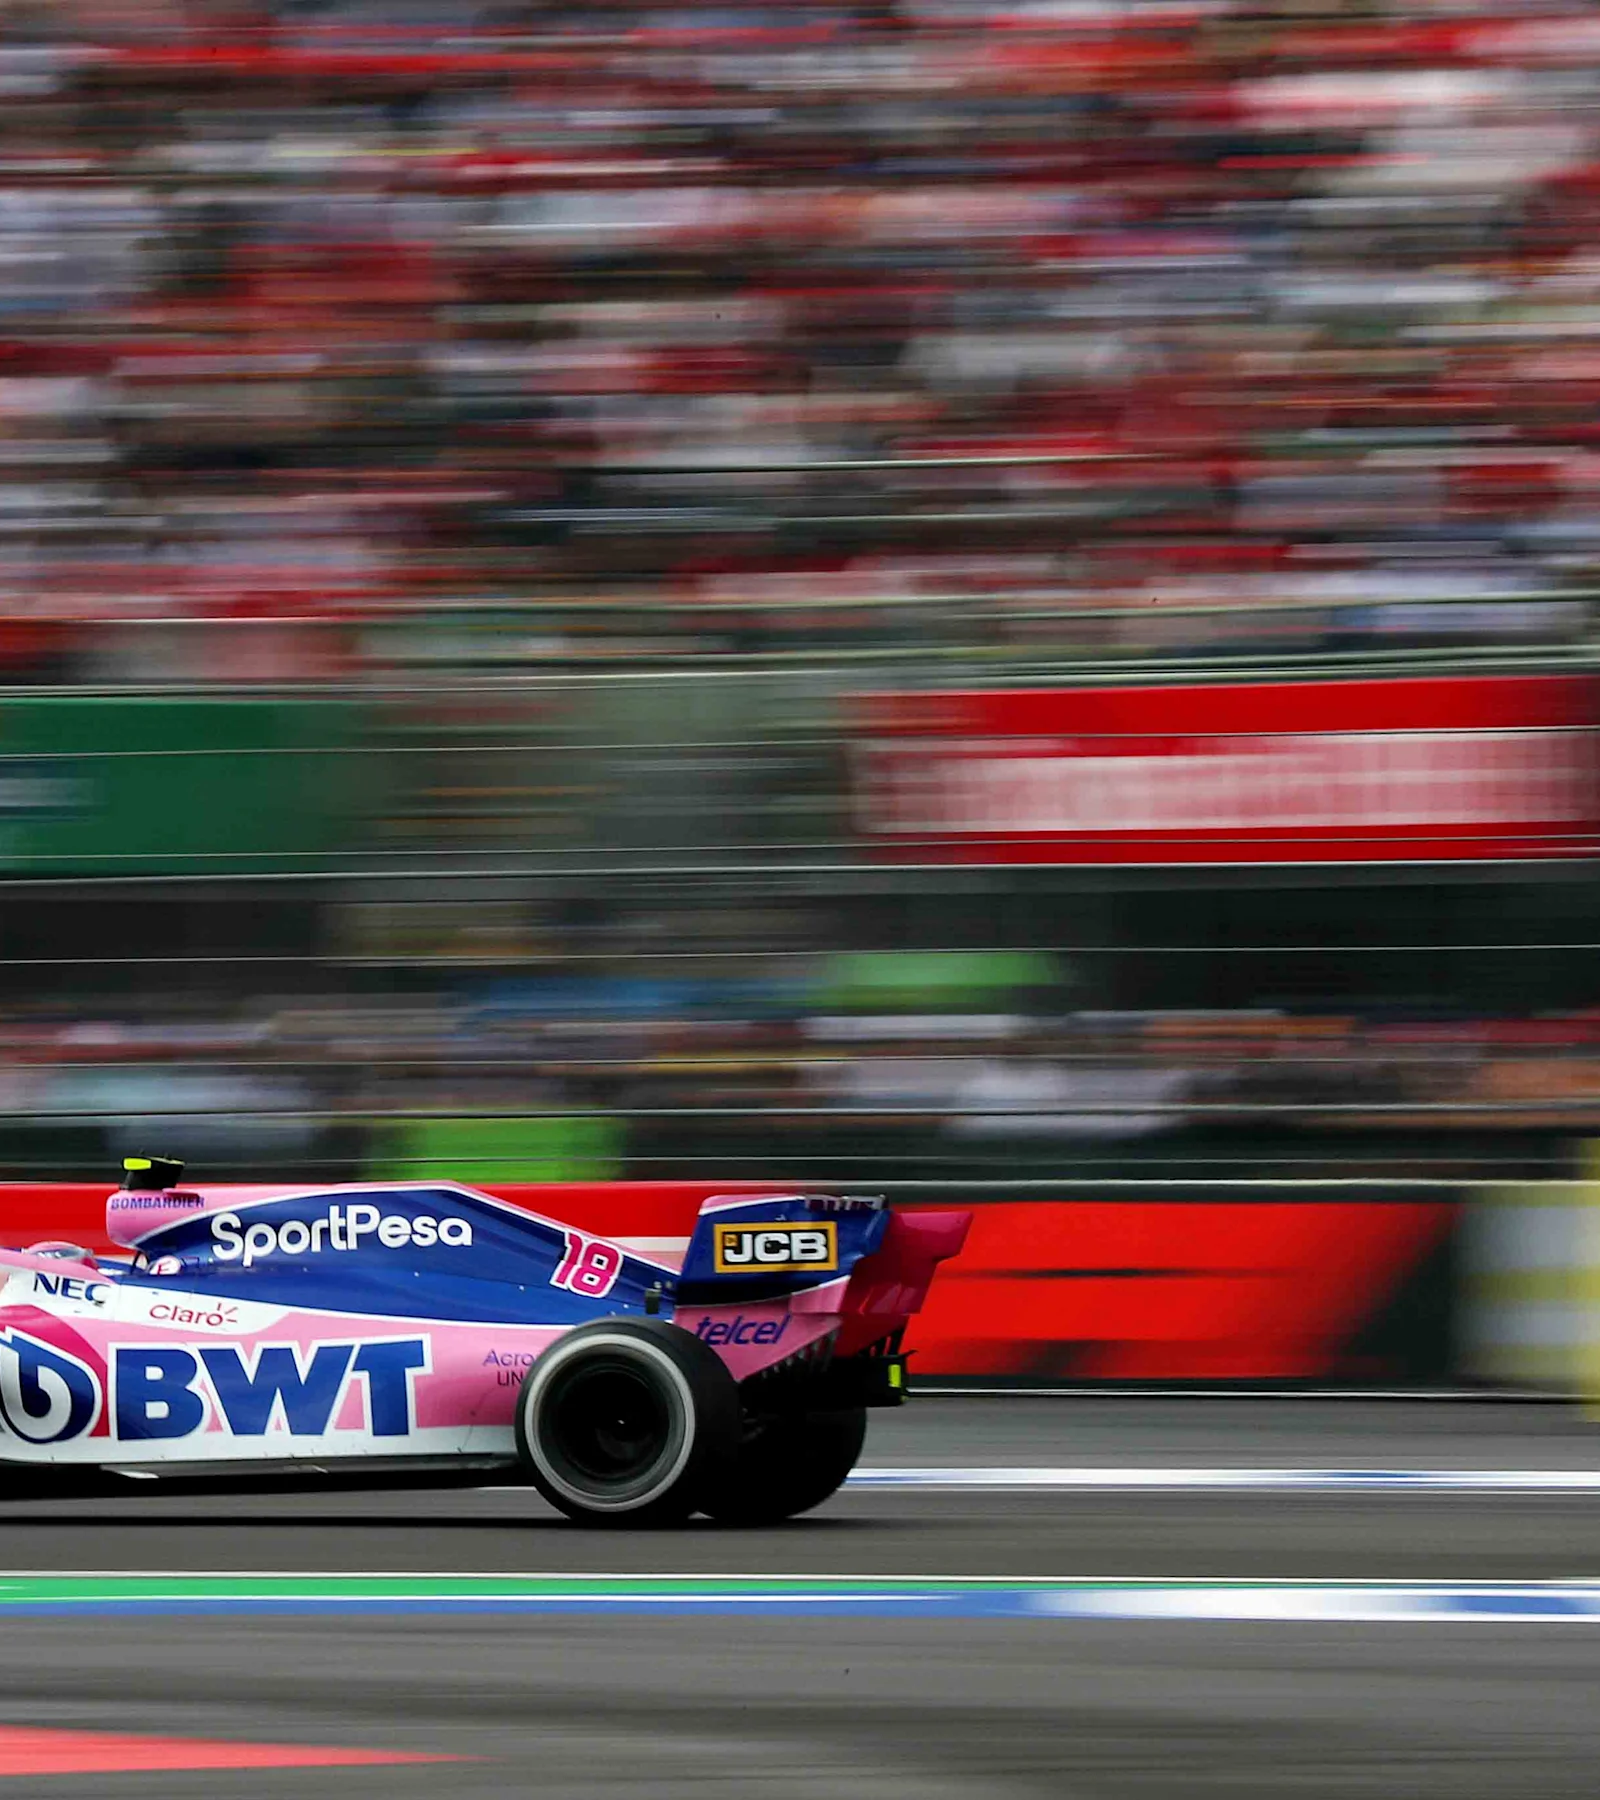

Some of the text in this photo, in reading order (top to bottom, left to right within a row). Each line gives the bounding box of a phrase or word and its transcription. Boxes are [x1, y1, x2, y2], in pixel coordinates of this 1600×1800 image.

[111, 1197, 205, 1210] BOMBARDIER
[211, 1205, 472, 1267] SportPesa
[724, 1232, 828, 1262] JCB
[550, 1231, 623, 1297] 18
[34, 1272, 111, 1305] NEC
[149, 1305, 223, 1326] Claro
[696, 1315, 791, 1345] telcel
[115, 1340, 425, 1441] BWT
